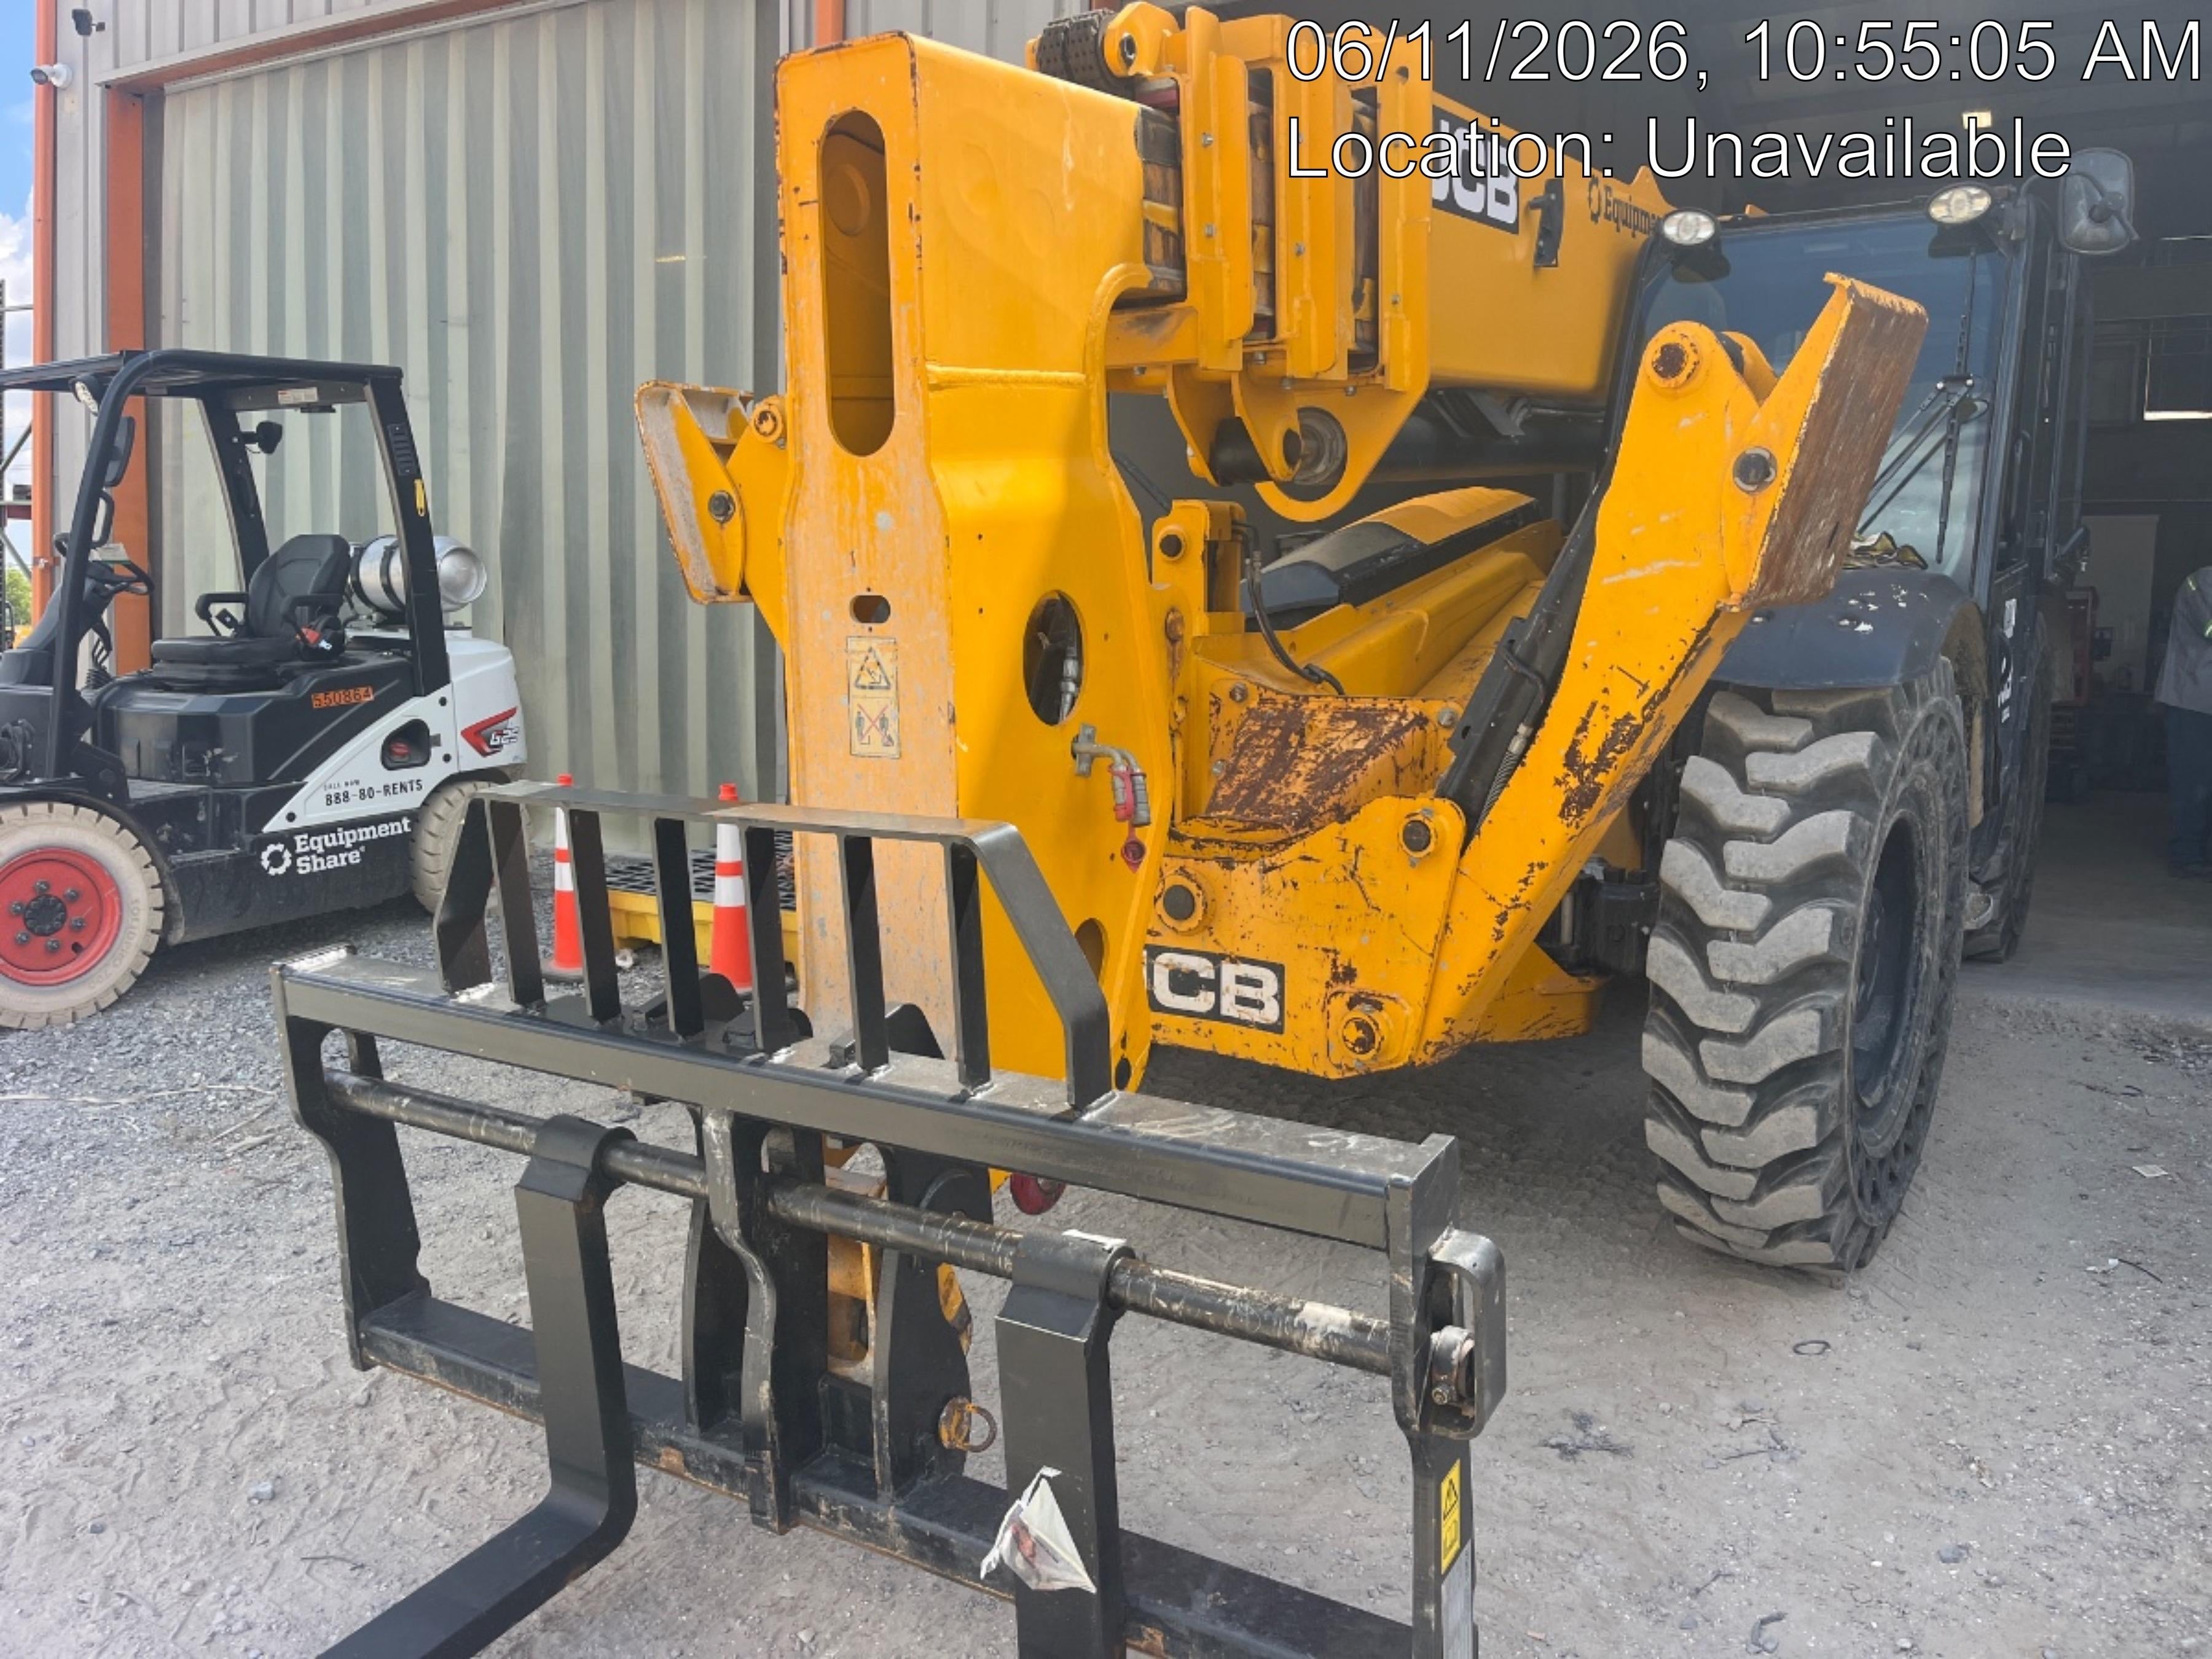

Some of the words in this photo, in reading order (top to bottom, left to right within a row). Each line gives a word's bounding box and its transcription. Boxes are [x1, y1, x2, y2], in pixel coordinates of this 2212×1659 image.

[325, 779, 423, 806] 888-80-RENTS
[294, 817, 412, 853] Equipment
[1143, 950, 1280, 1025] CB
